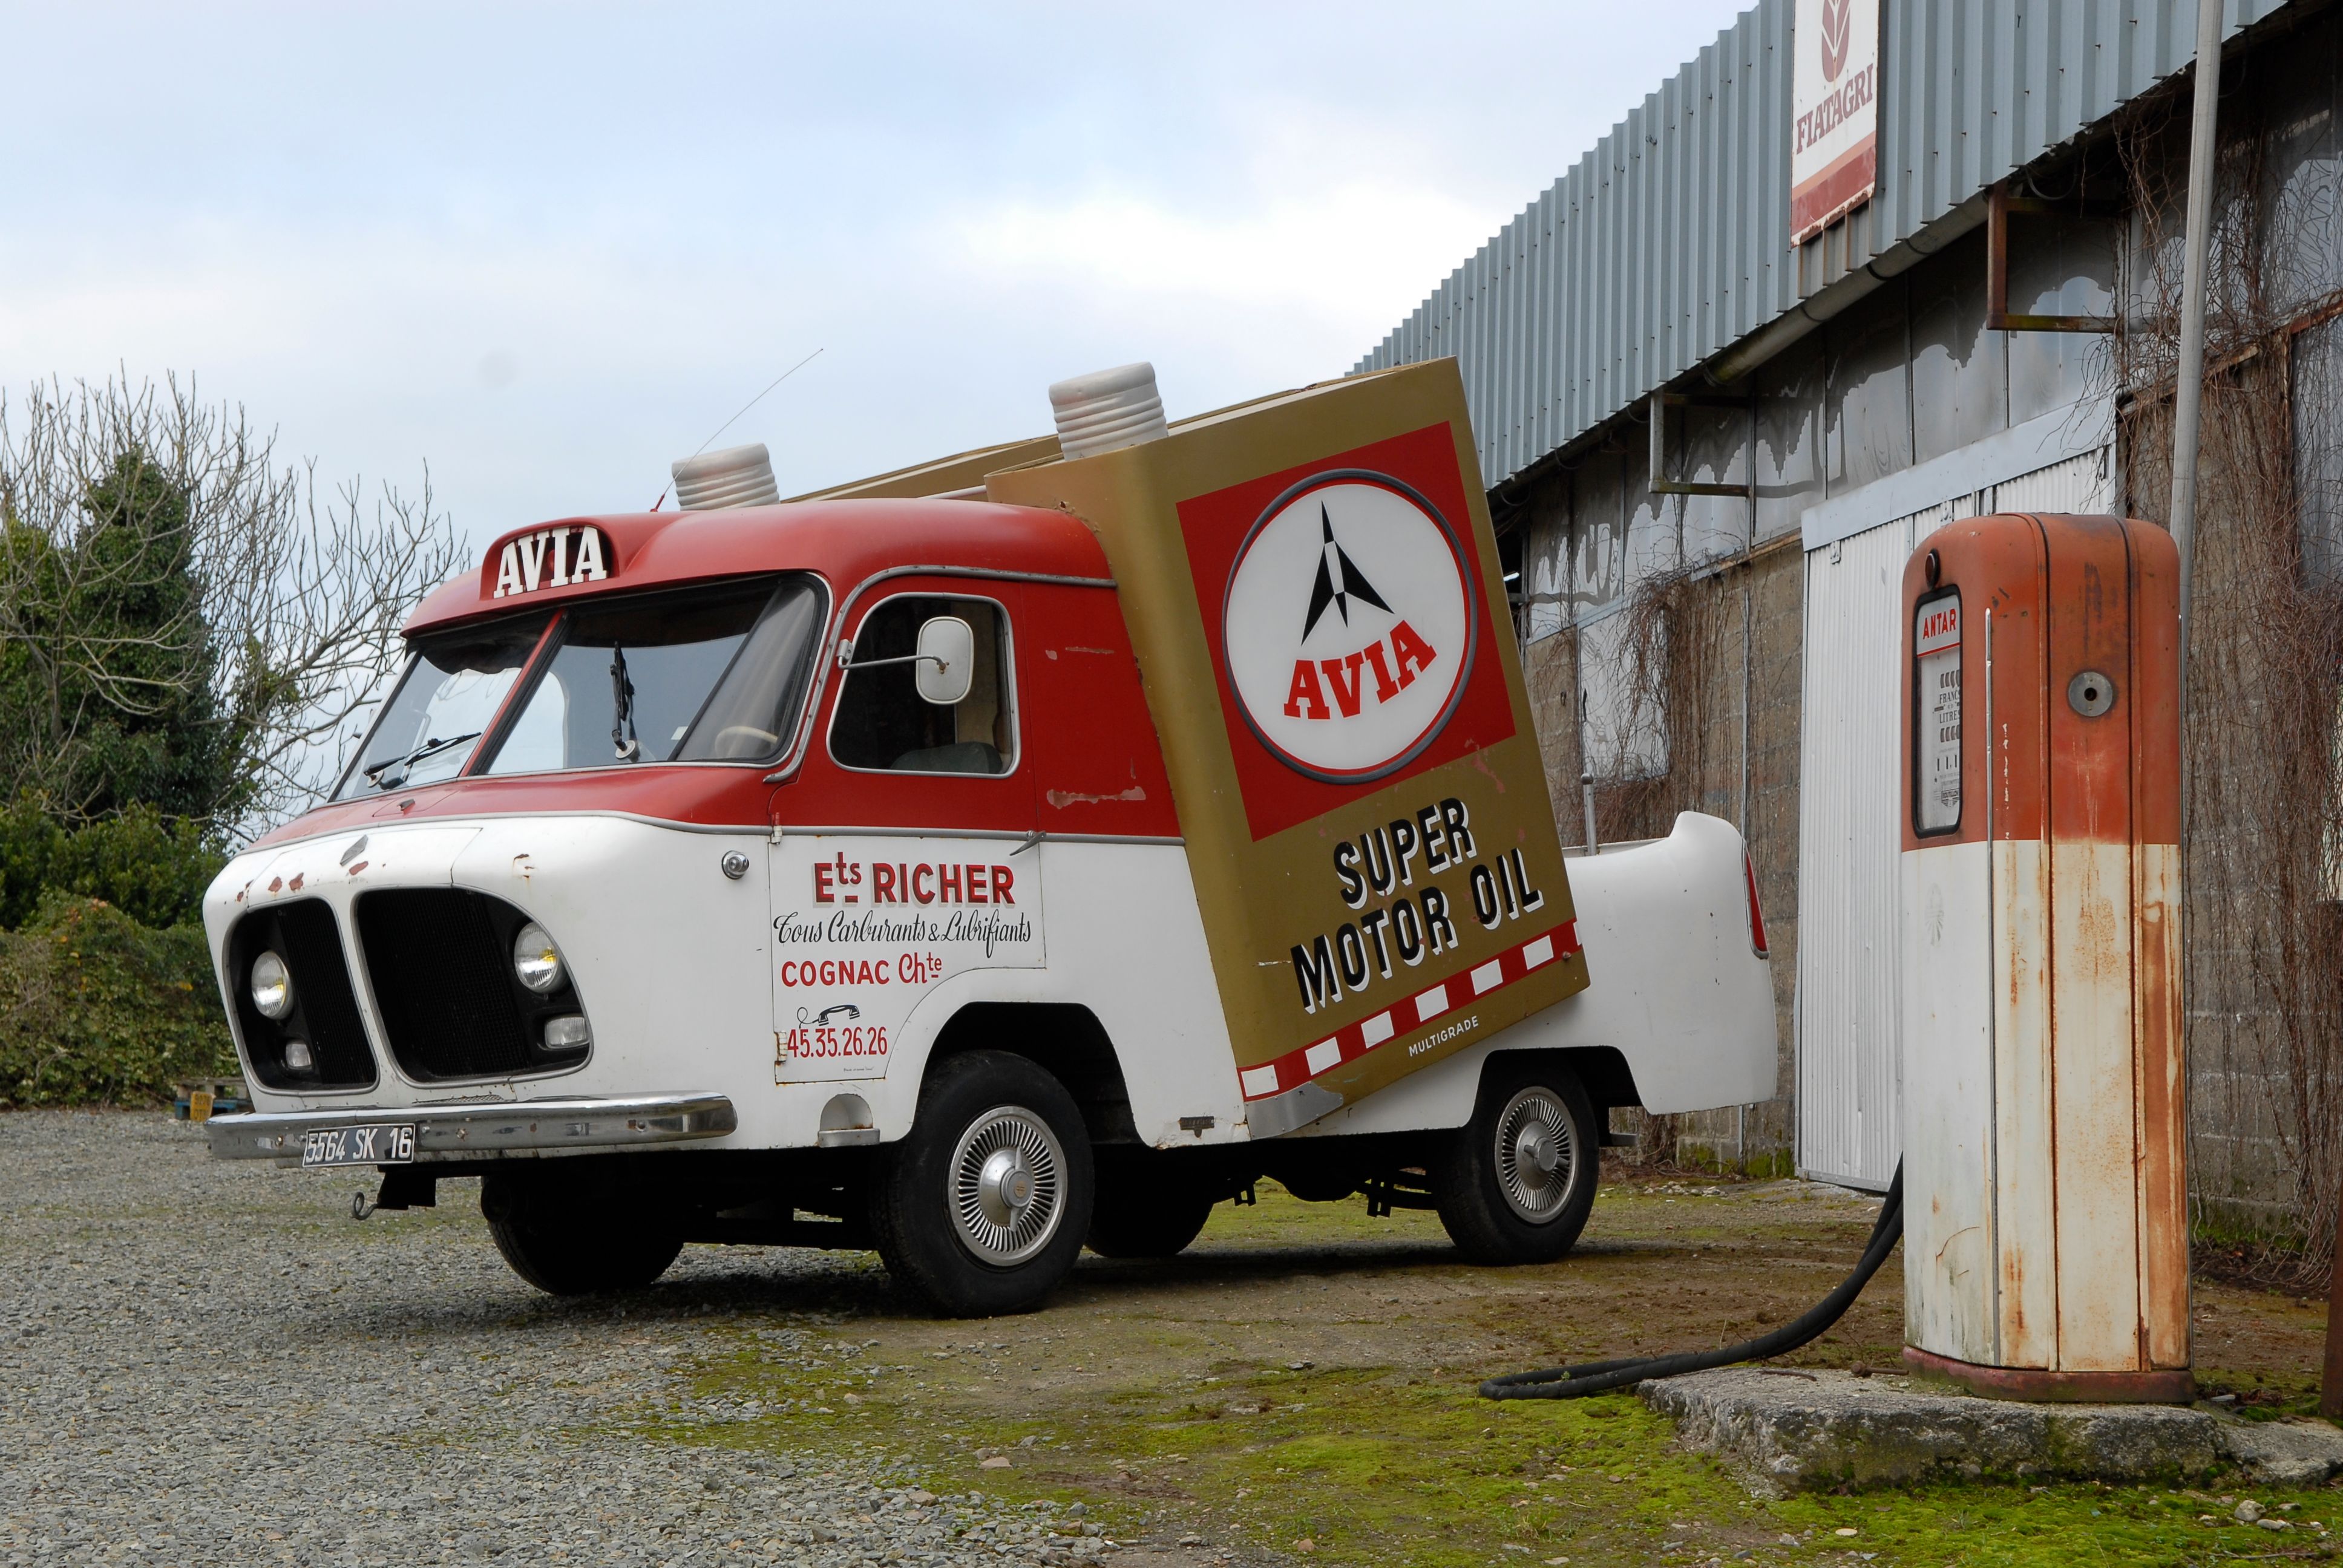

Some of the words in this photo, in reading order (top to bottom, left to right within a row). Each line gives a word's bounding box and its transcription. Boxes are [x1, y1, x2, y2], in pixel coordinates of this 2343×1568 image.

[1797, 63, 1874, 155] FIATAGRI
[493, 525, 608, 599] AVIA
[1922, 609, 1956, 639] ANTAR
[1283, 619, 1437, 720] AVIA
[1333, 797, 1476, 909] SUPER
[872, 862, 1015, 905] RICHER
[773, 912, 822, 943] Tous
[827, 910, 925, 942] Carburants
[928, 923, 940, 941] &
[940, 909, 1031, 958] Lubrifiants
[1290, 886, 1458, 1014] MOTOR
[1469, 848, 1544, 930] OIL
[781, 959, 890, 987] COGNAC
[898, 952, 943, 984] Chte
[787, 1026, 888, 1058] 45.35.26.26
[1409, 1015, 1479, 1057] MULTIGRADE
[306, 1131, 347, 1163] 5564
[353, 1128, 378, 1159] SK
[389, 1127, 413, 1158] 16
